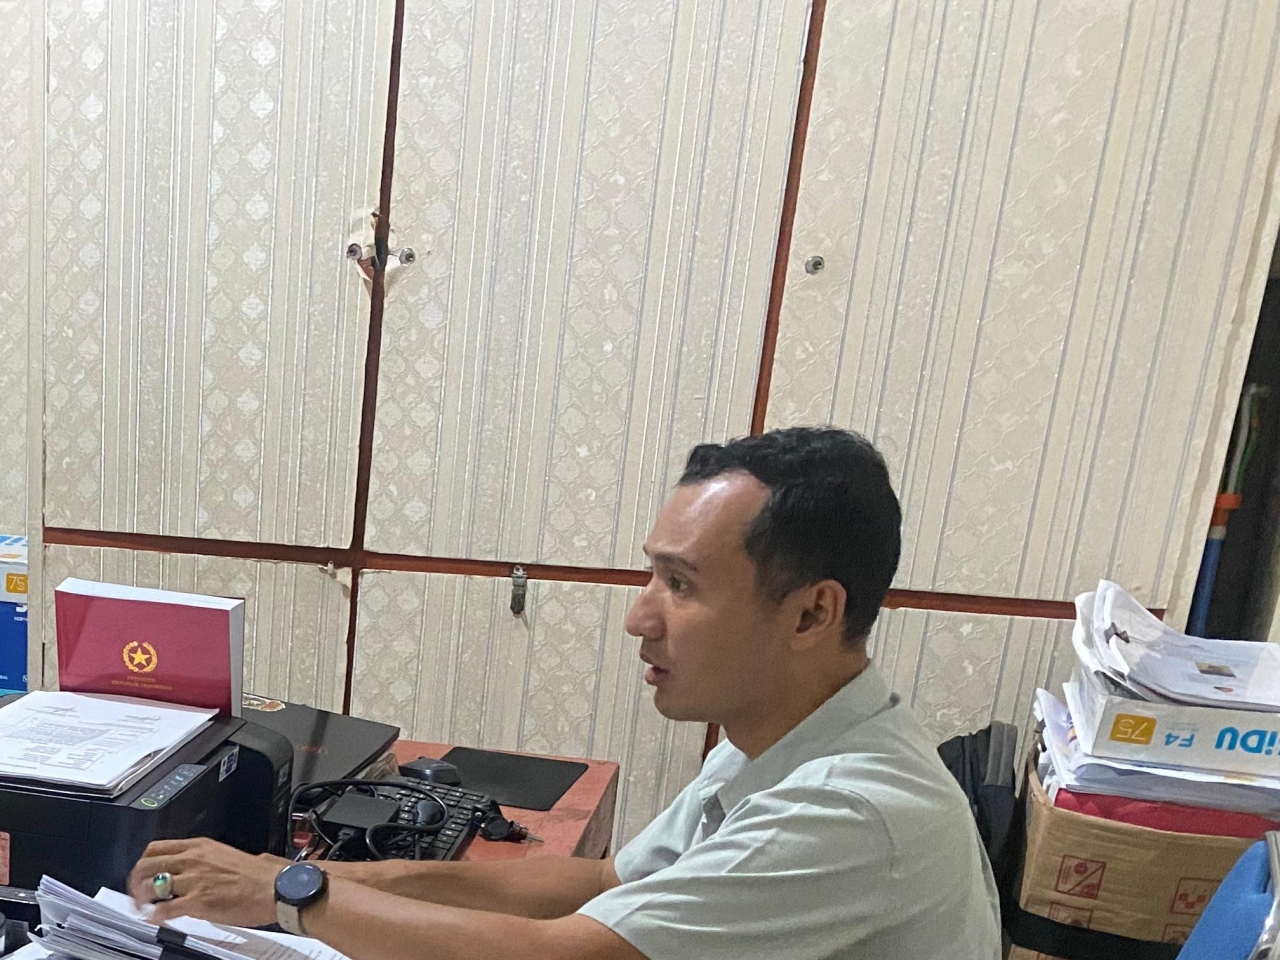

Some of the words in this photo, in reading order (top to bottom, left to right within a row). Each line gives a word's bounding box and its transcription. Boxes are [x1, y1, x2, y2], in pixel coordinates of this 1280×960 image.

[1116, 719, 1148, 741] 75
[1164, 732, 1195, 748] F4
[1215, 726, 1280, 756] iDU
